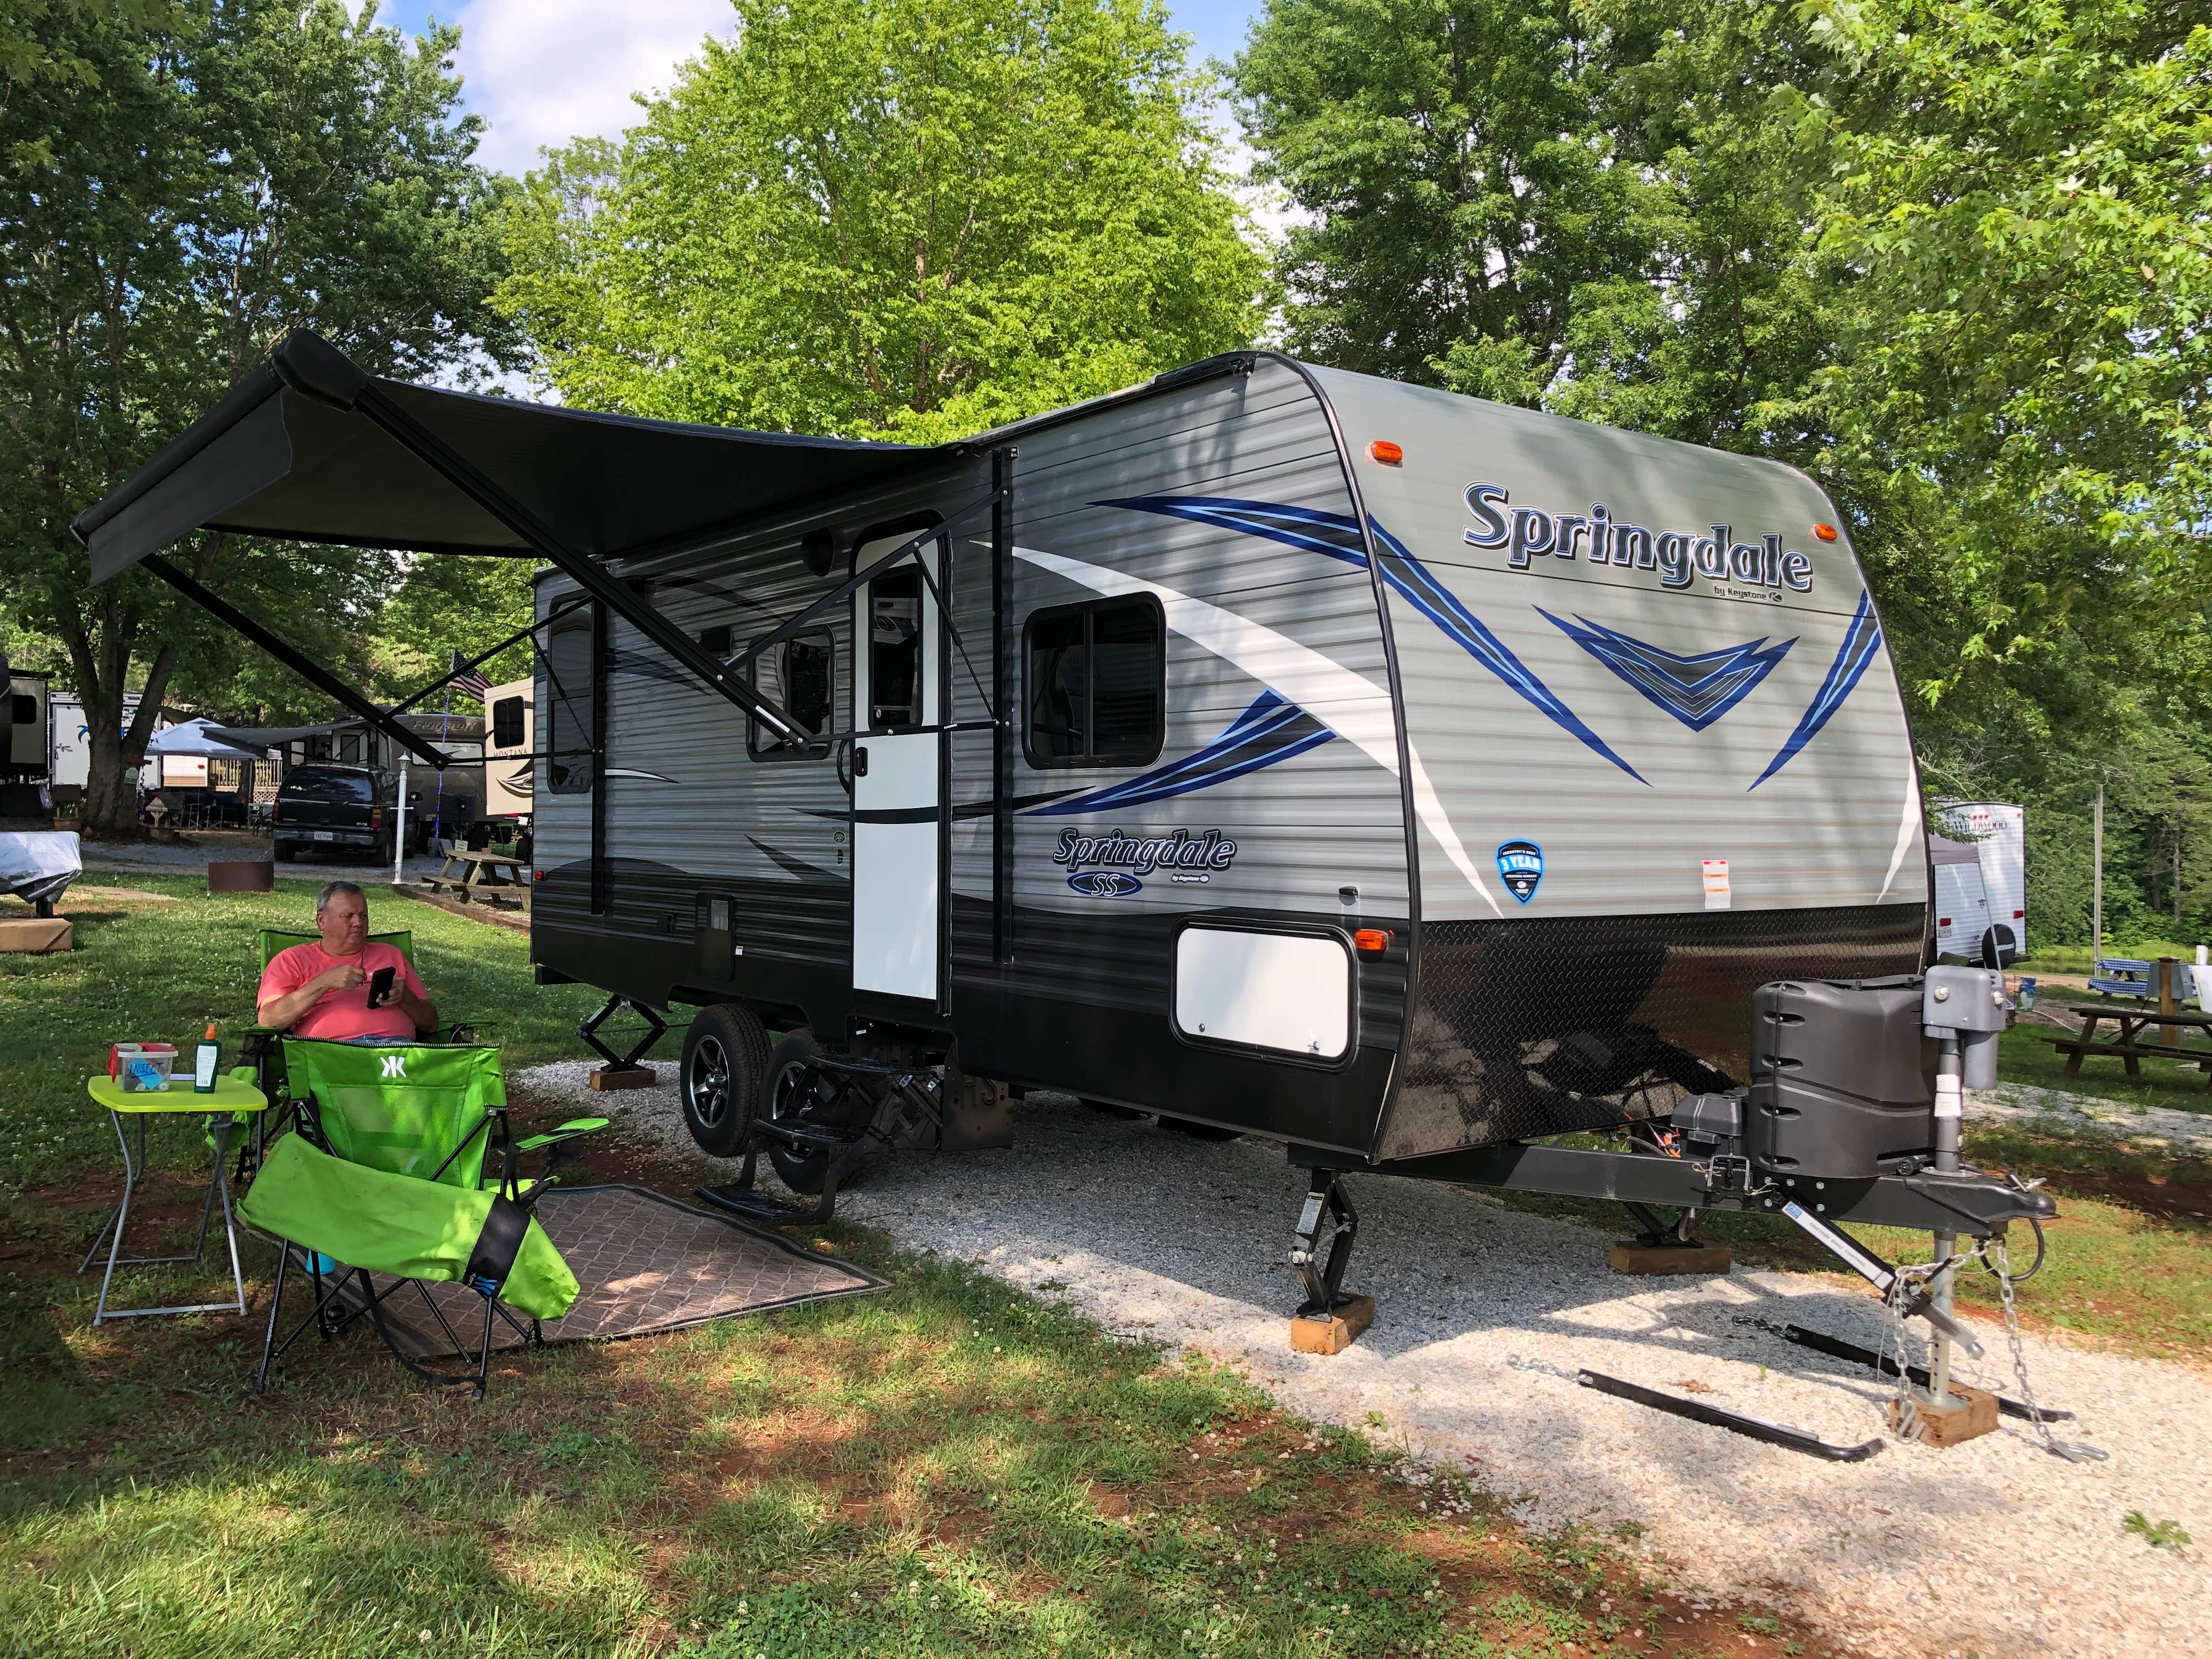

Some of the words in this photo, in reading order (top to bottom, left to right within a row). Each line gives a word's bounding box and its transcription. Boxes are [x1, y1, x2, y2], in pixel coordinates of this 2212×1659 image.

[1463, 481, 1814, 592] Springdale
[1714, 585, 1725, 596] by
[1728, 588, 1767, 600] Keystone
[493, 747, 527, 757] MONTANA
[1954, 820, 2007, 833] WILDWOOD
[1053, 827, 1238, 875] Springdale
[1500, 859, 1510, 871] 3
[1509, 856, 1541, 871] YEAR
[1091, 872, 1120, 896] SS
[1809, 1221, 1830, 1240] FRICTION
[1844, 1250, 1866, 1268] CONTROL
